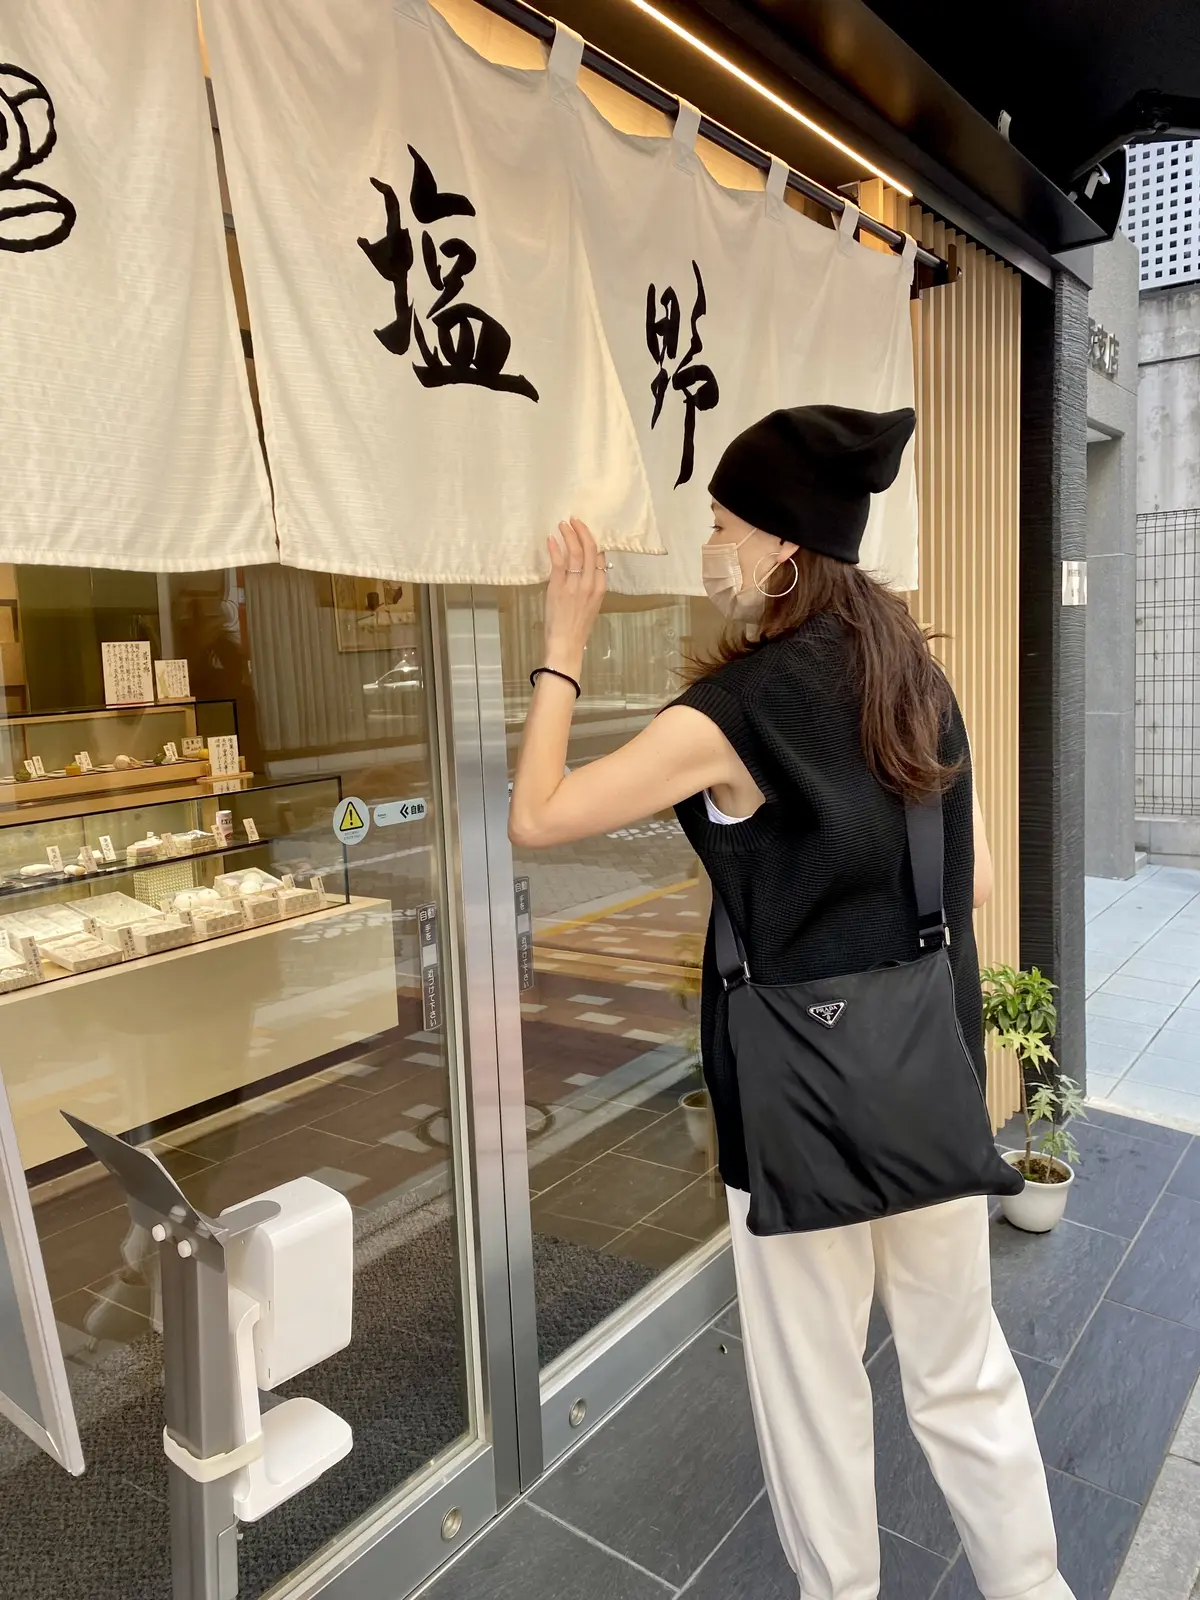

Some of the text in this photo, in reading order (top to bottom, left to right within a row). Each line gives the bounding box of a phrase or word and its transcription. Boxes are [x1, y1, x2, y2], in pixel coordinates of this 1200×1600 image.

[357, 143, 720, 490] 塩 野
[410, 803, 425, 815] 自動
[419, 907, 436, 922] 自動
[816, 1005, 838, 1014] PRADA
